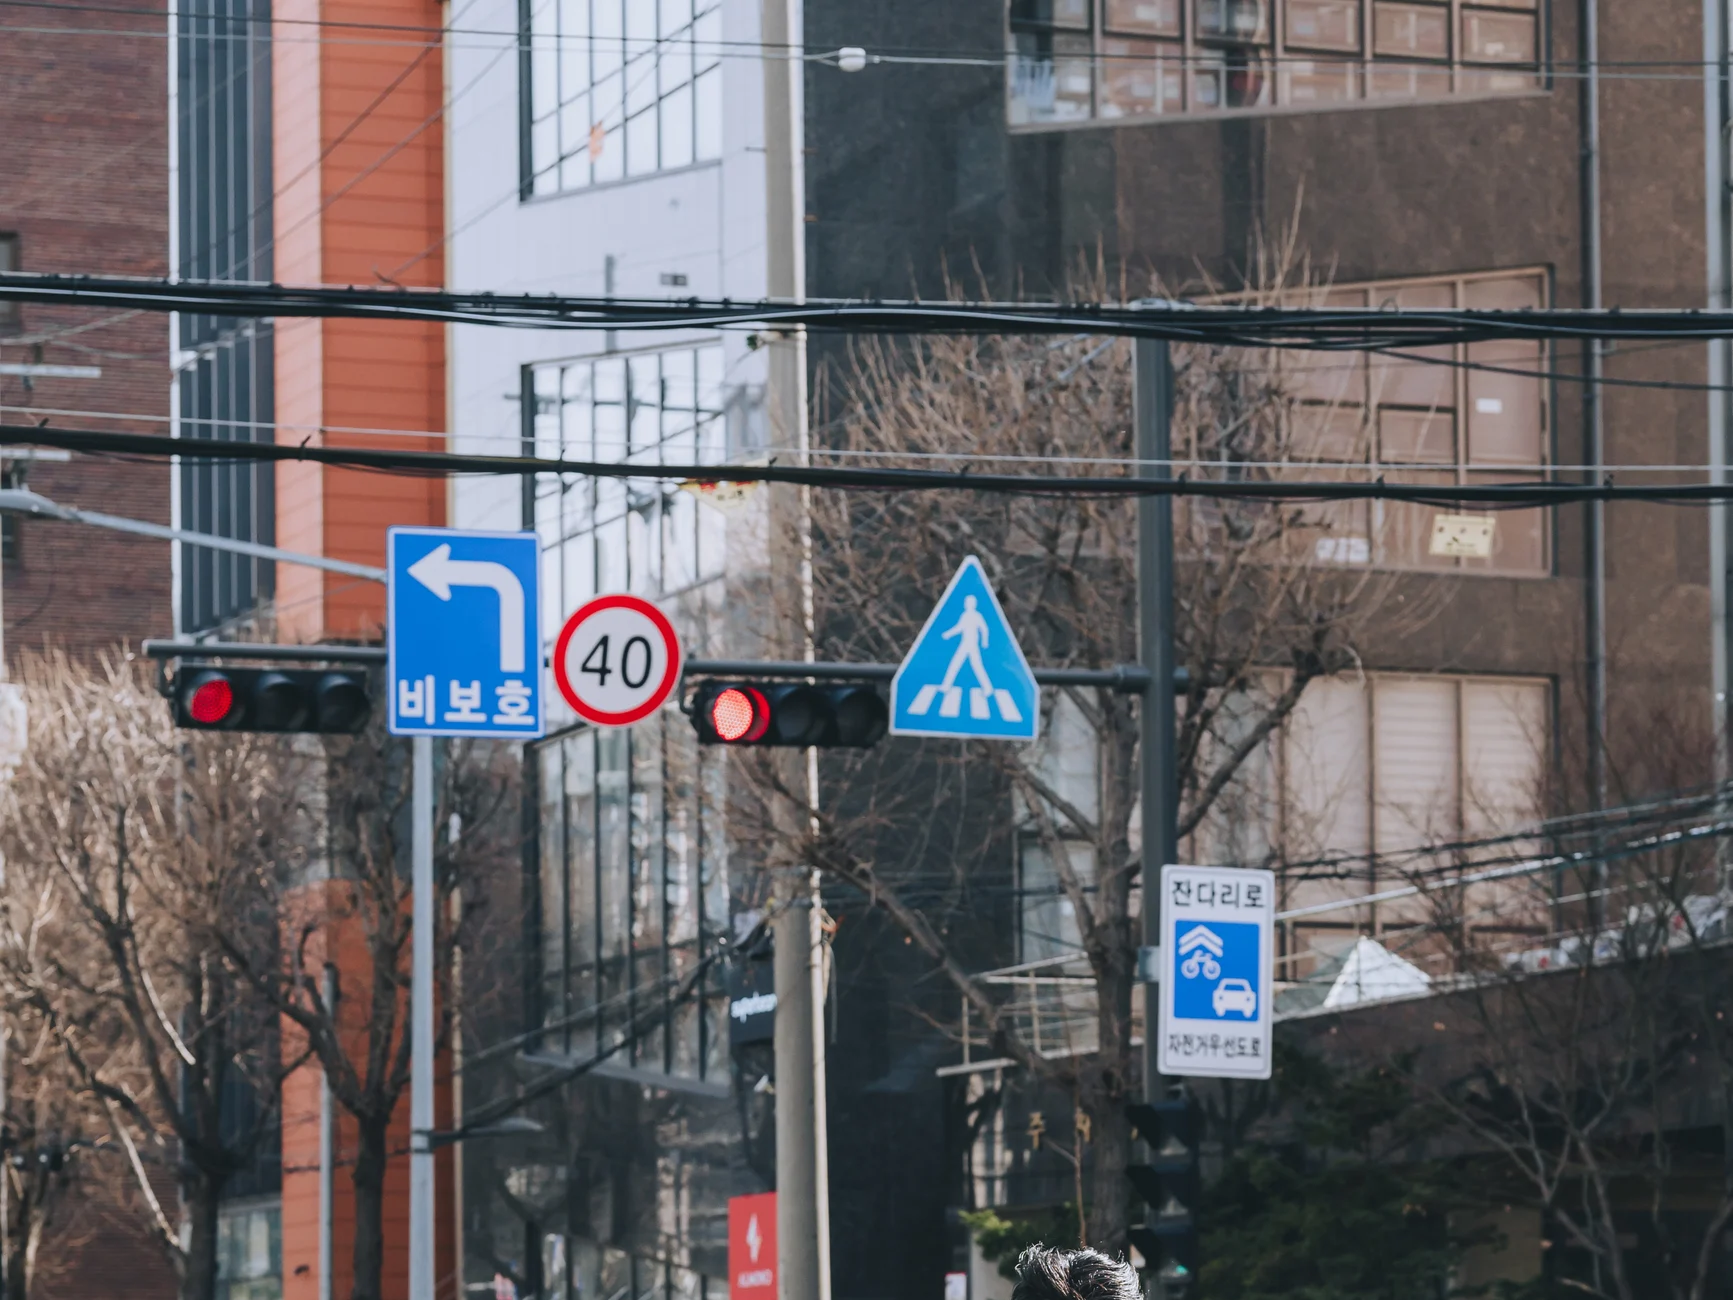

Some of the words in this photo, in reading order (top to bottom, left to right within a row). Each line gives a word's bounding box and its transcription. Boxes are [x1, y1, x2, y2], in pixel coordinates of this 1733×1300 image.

[580, 634, 652, 689] 40
[399, 674, 536, 726] 비보호
[1172, 879, 1265, 909] 잔다리로
[1168, 1033, 1262, 1058] 자전거우선도로
